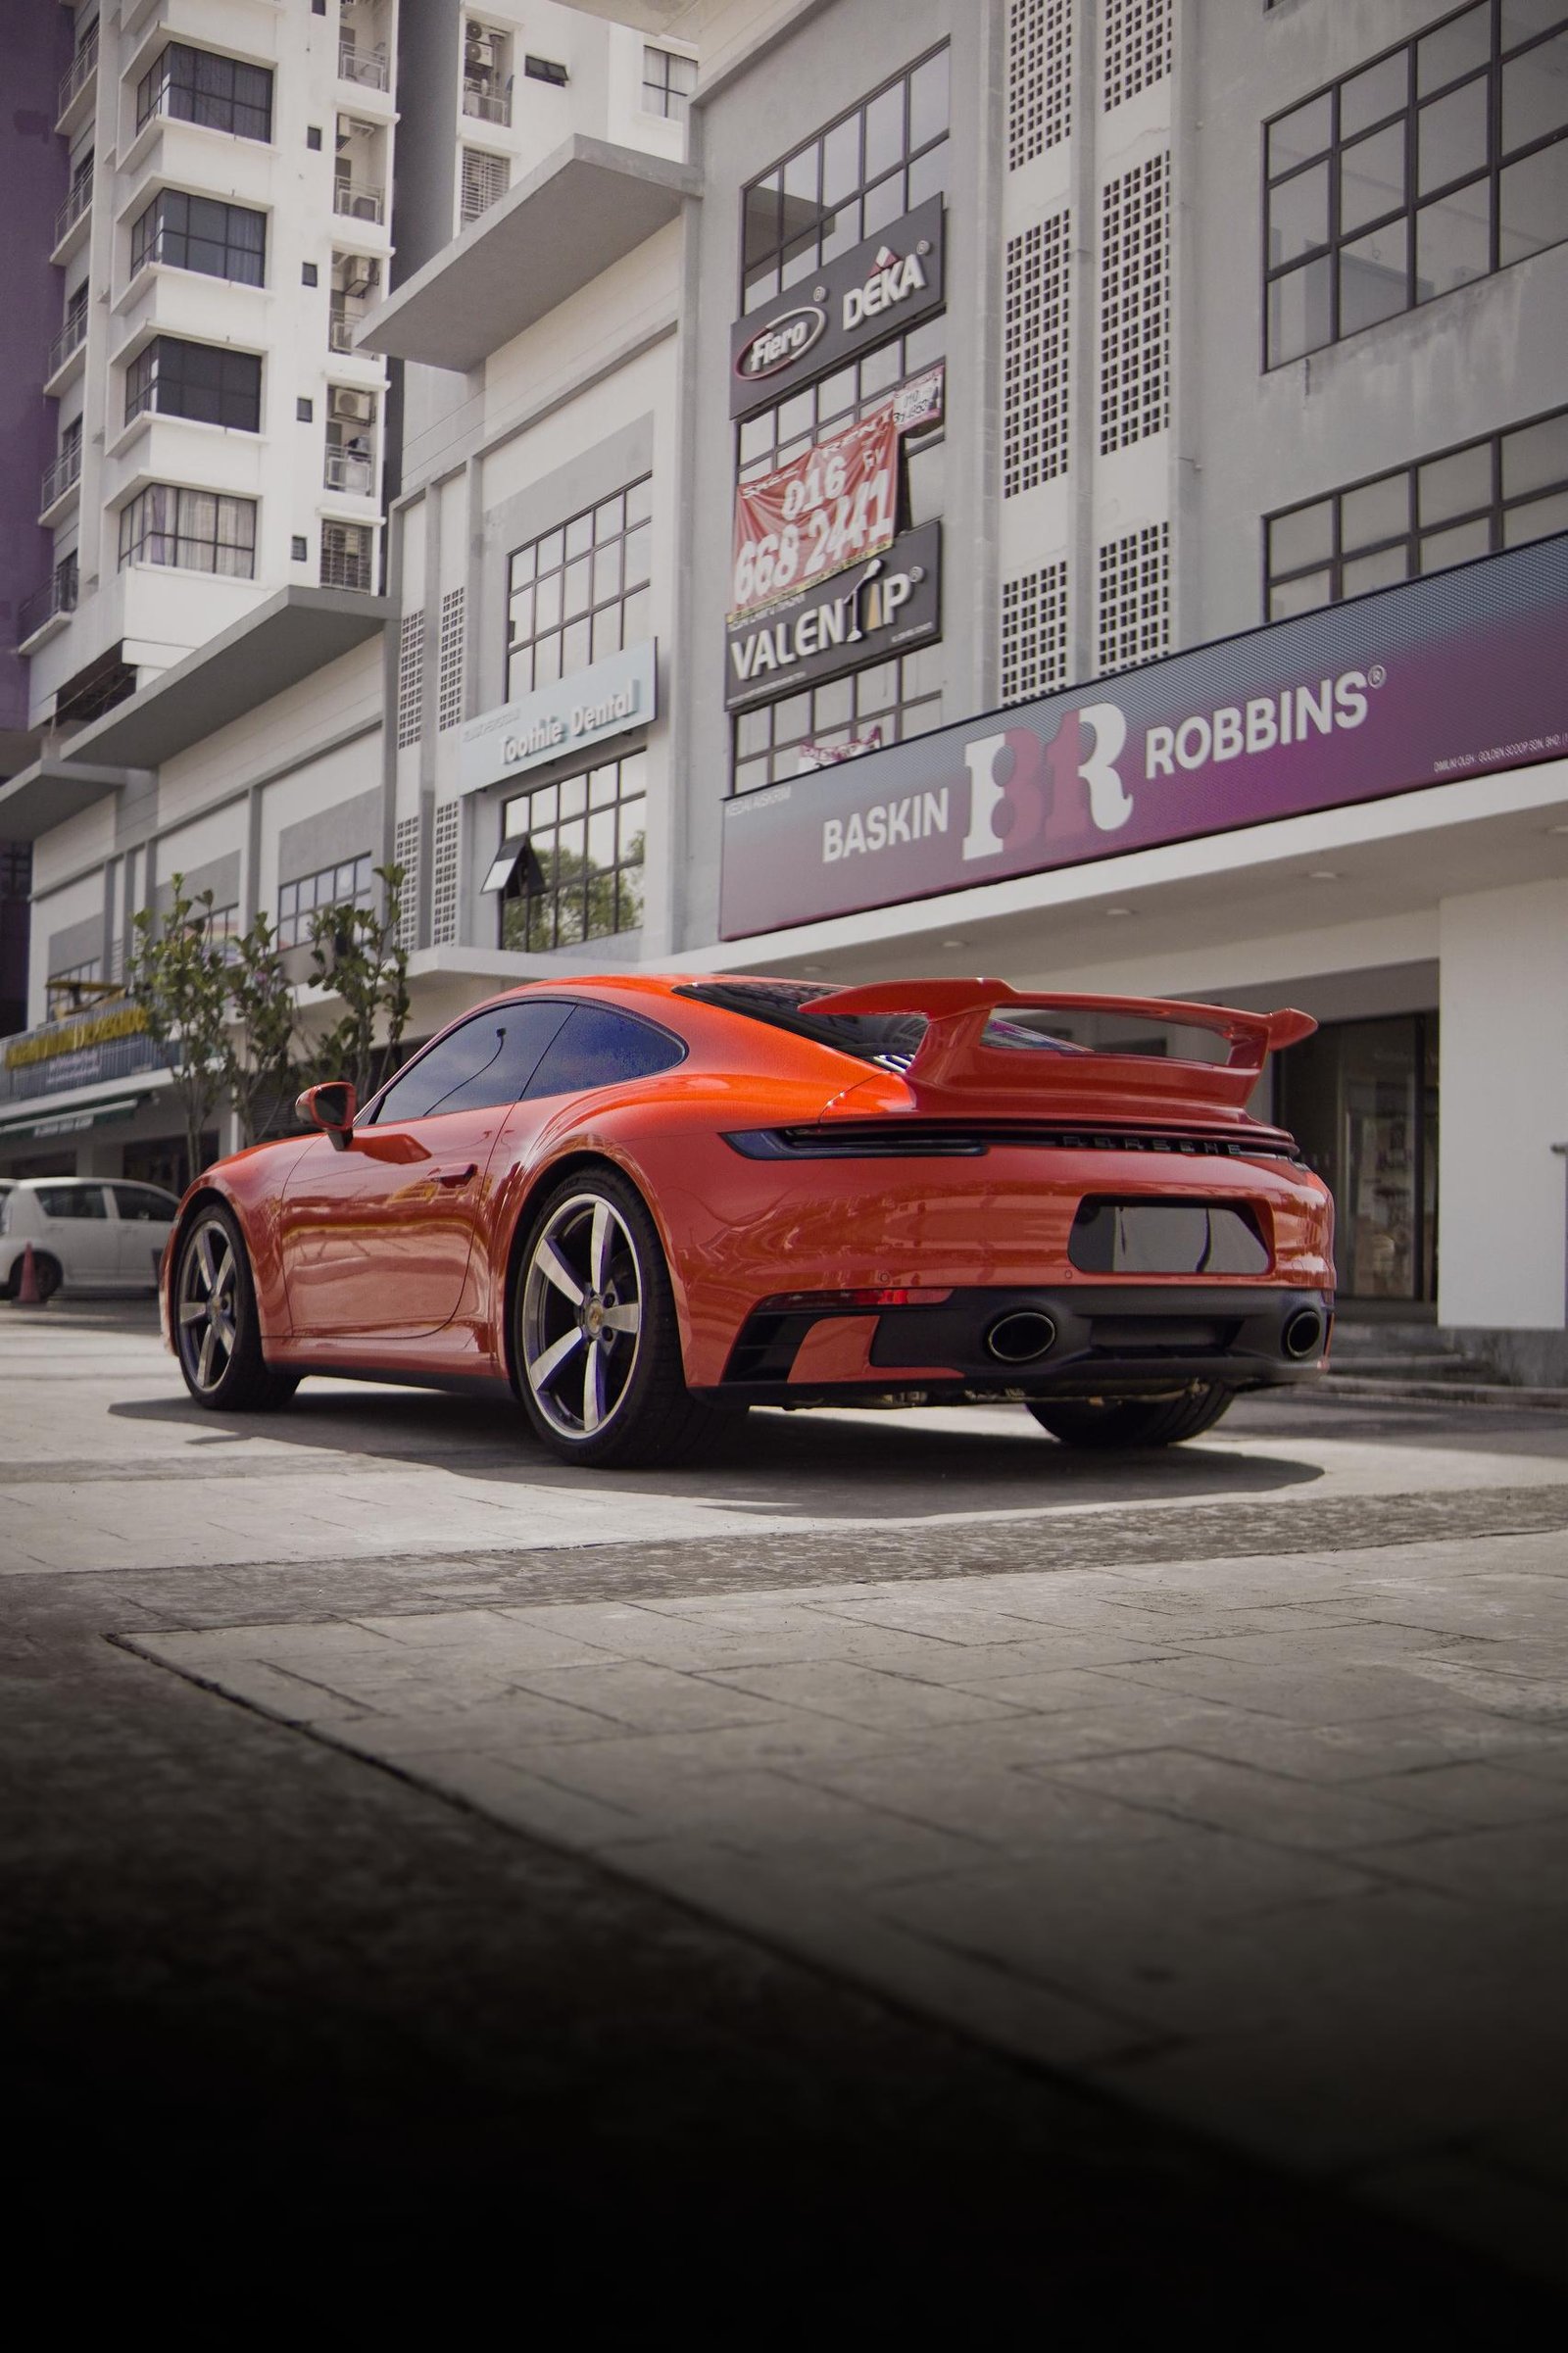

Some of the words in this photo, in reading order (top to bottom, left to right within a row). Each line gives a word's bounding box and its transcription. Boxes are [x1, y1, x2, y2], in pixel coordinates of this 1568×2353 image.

[843, 252, 927, 331] DEKA
[751, 320, 808, 372] Fiero
[781, 455, 847, 521] 016
[735, 523, 800, 605] 668
[804, 468, 893, 577] 2441
[501, 712, 565, 765] Toothie
[570, 678, 641, 737] Dental
[821, 787, 950, 863] BASKIN
[1145, 669, 1368, 780] ROBBINS
[1062, 1135, 1242, 1155] PORSCHE
